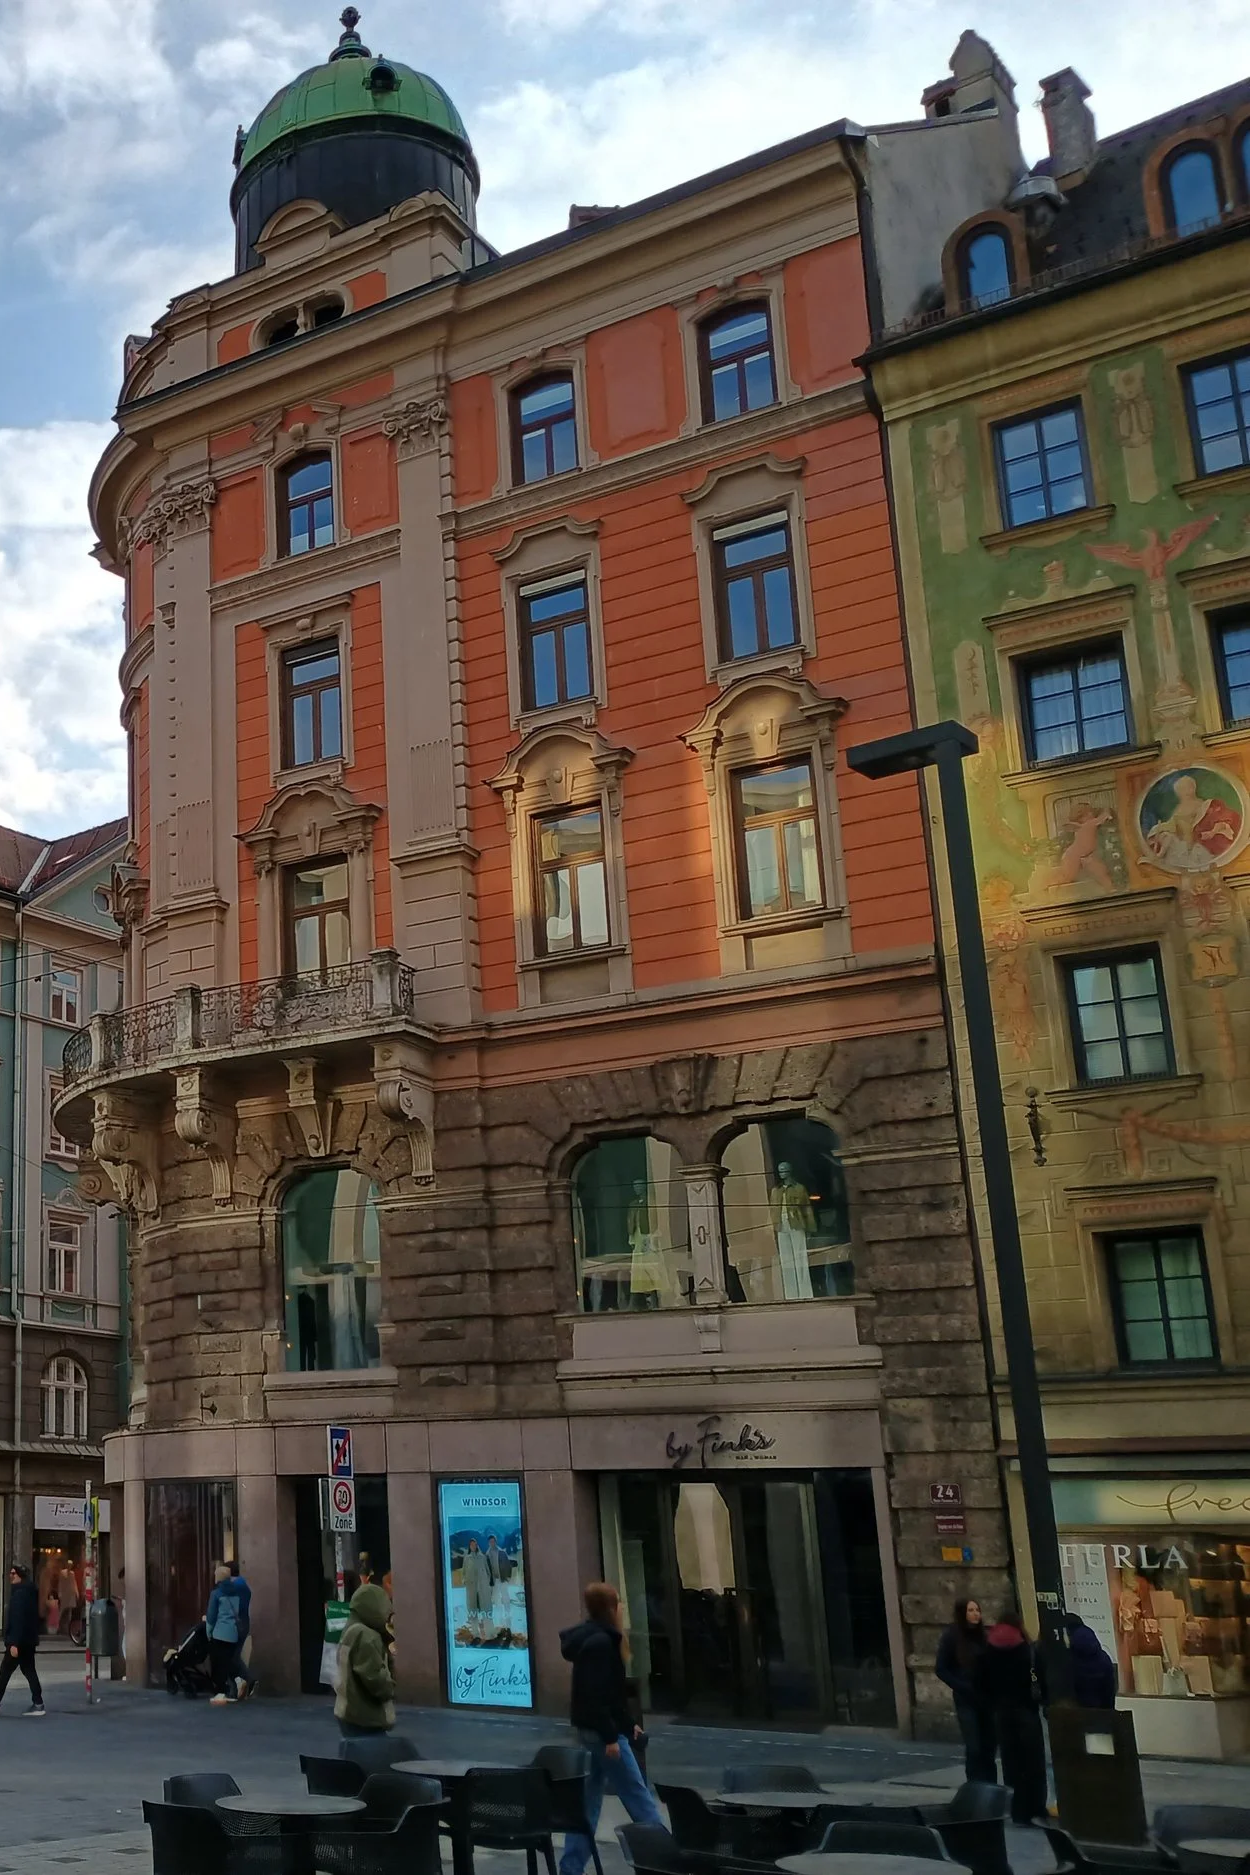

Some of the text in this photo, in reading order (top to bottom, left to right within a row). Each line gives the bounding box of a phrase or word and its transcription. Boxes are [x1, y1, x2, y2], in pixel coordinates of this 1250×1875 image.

[665, 1415, 776, 1469] by Fink's
[936, 1485, 954, 1498] 24
[462, 1497, 508, 1507] WINDSOR
[335, 1515, 353, 1529] Zone
[1058, 1544, 1189, 1570] FURLA
[455, 1655, 531, 1698] by Fink's
